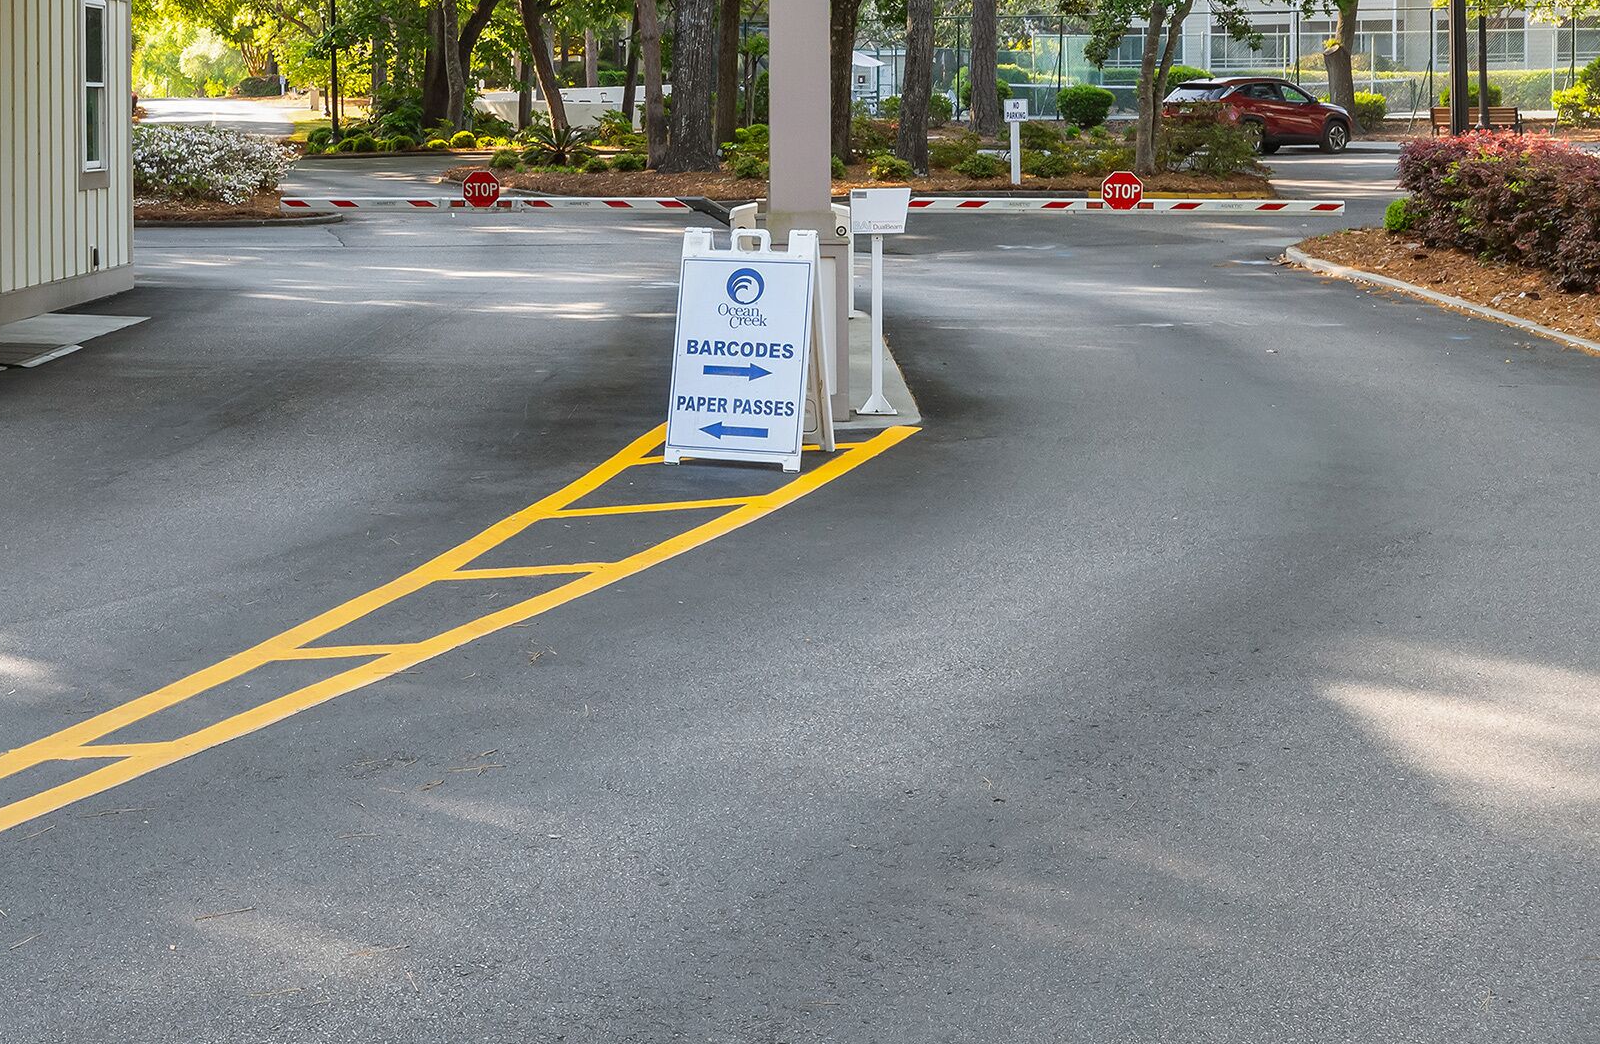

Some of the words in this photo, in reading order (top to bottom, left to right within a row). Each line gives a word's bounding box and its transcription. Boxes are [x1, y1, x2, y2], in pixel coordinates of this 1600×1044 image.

[1012, 101, 1020, 110] NO
[1006, 111, 1026, 120] PARKING
[465, 182, 498, 197] STOP
[1104, 183, 1141, 199] STOP
[717, 302, 760, 317] Ocean
[729, 314, 768, 329] Creek
[686, 339, 795, 360] BARCODES
[676, 395, 728, 414] PAPER
[732, 398, 795, 417] PASSES
